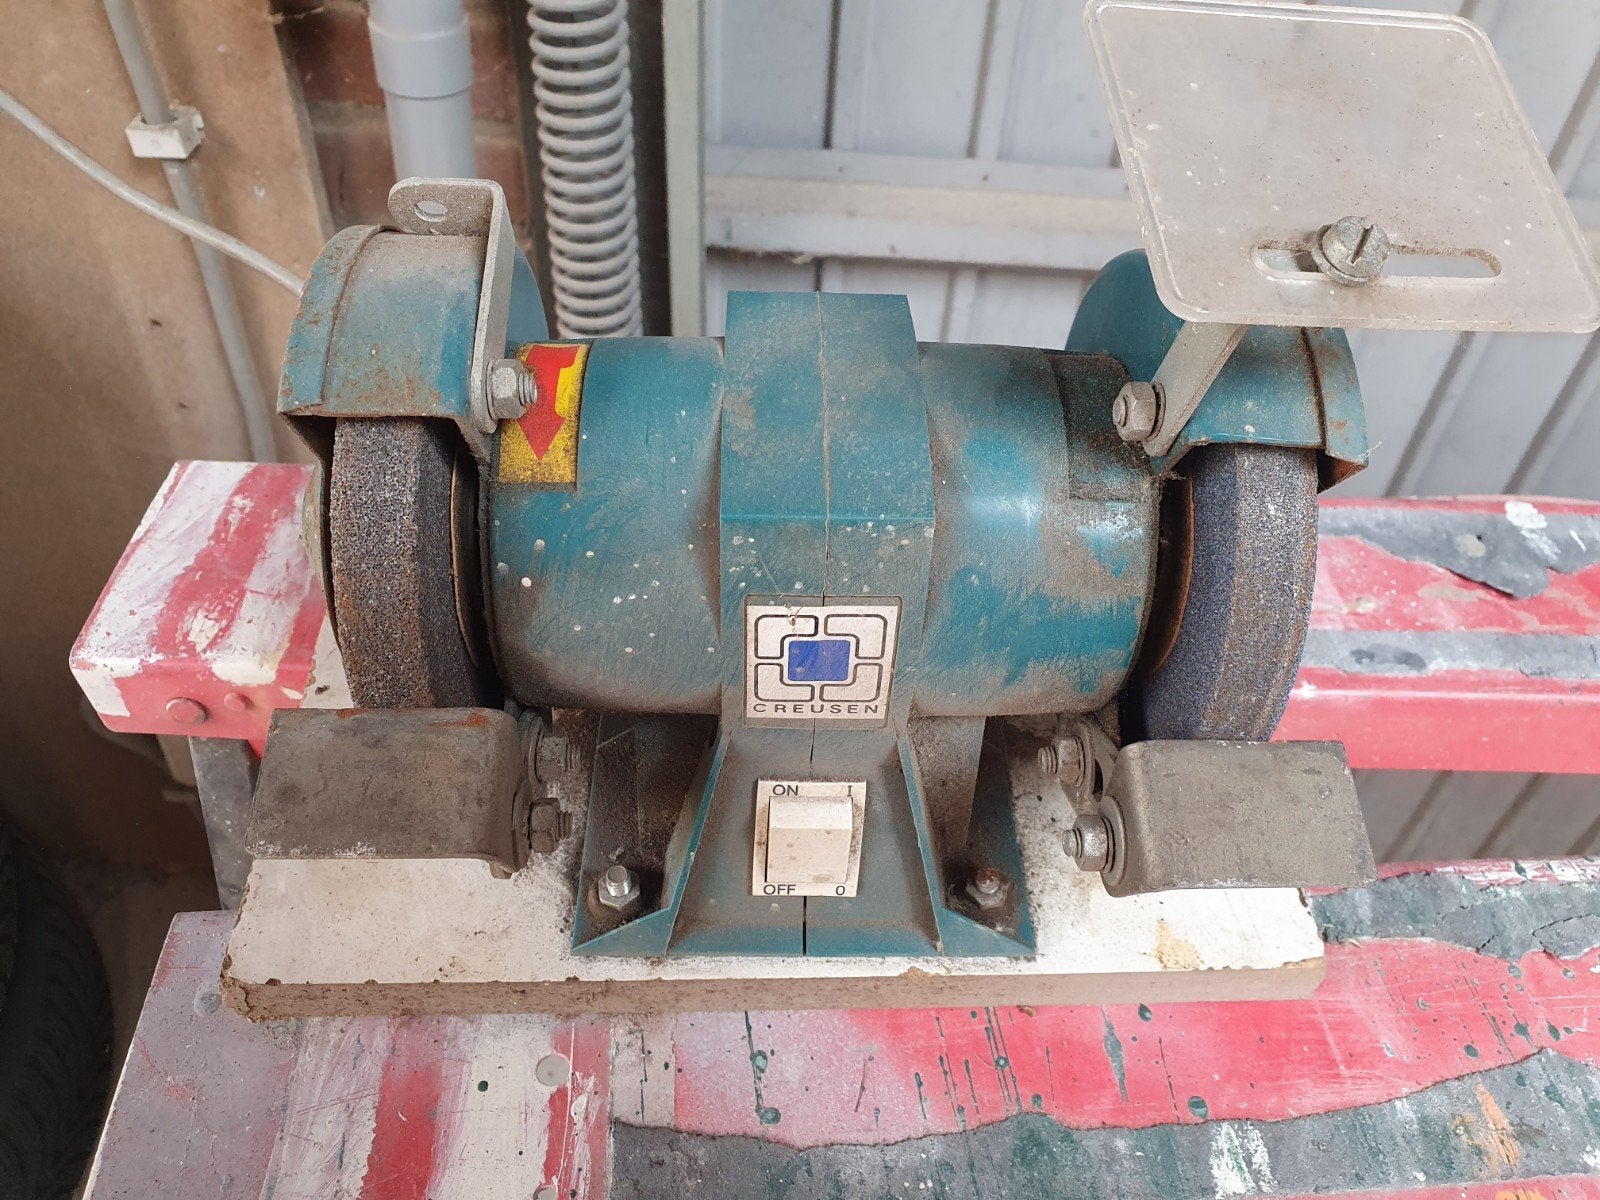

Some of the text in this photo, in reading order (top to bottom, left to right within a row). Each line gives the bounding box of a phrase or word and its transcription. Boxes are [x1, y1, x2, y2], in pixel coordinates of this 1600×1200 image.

[753, 703, 878, 714] CREUSEN
[772, 784, 799, 796] ON
[763, 884, 796, 895] OFF
